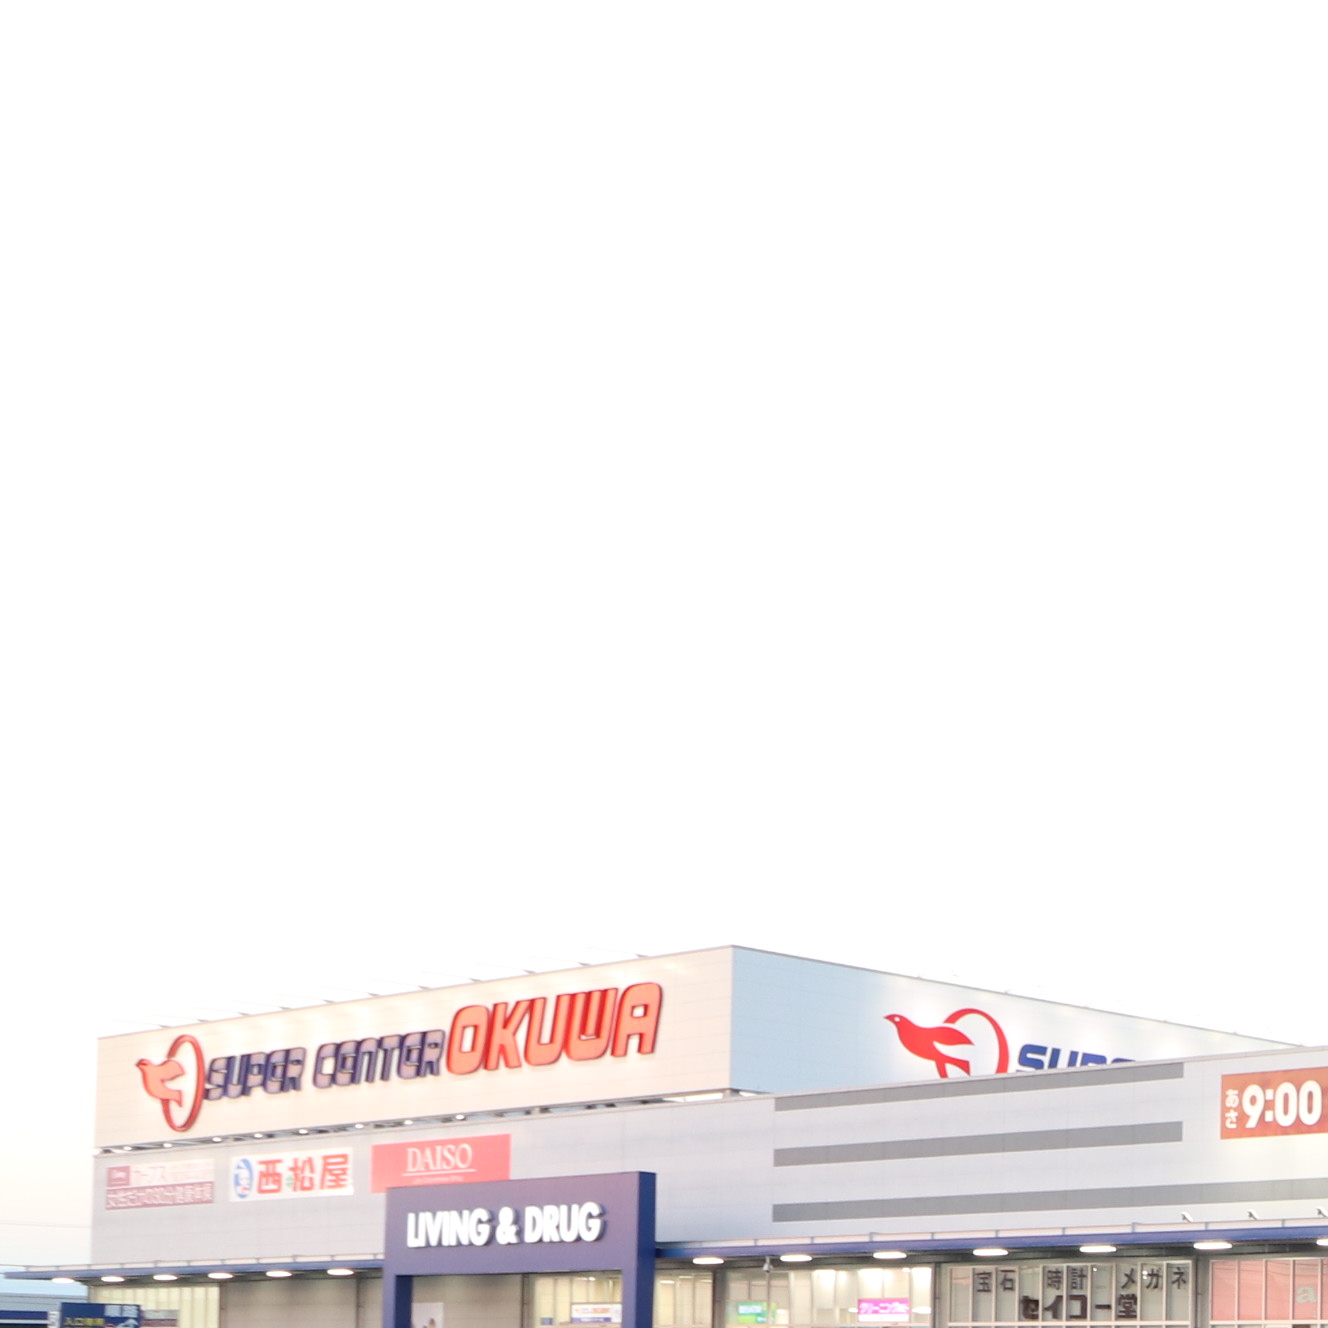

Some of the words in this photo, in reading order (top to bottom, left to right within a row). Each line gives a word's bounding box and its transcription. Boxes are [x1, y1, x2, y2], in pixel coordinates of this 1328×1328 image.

[203, 1047, 306, 1100] SUPER
[445, 982, 664, 1076] OKUWA
[1225, 1088, 1238, 1129] あさ
[1242, 1080, 1322, 1128] 9:00
[257, 1153, 350, 1194] 西松屋
[407, 1143, 473, 1172] DAISO
[407, 1208, 491, 1248] LIVING
[496, 1206, 518, 1244] &
[523, 1202, 603, 1243] DRUG
[976, 1269, 1016, 1293] 宝石
[1047, 1267, 1087, 1290] 時計
[1121, 1266, 1188, 1290] メガネ
[1021, 1293, 1138, 1320] セイコー堂
